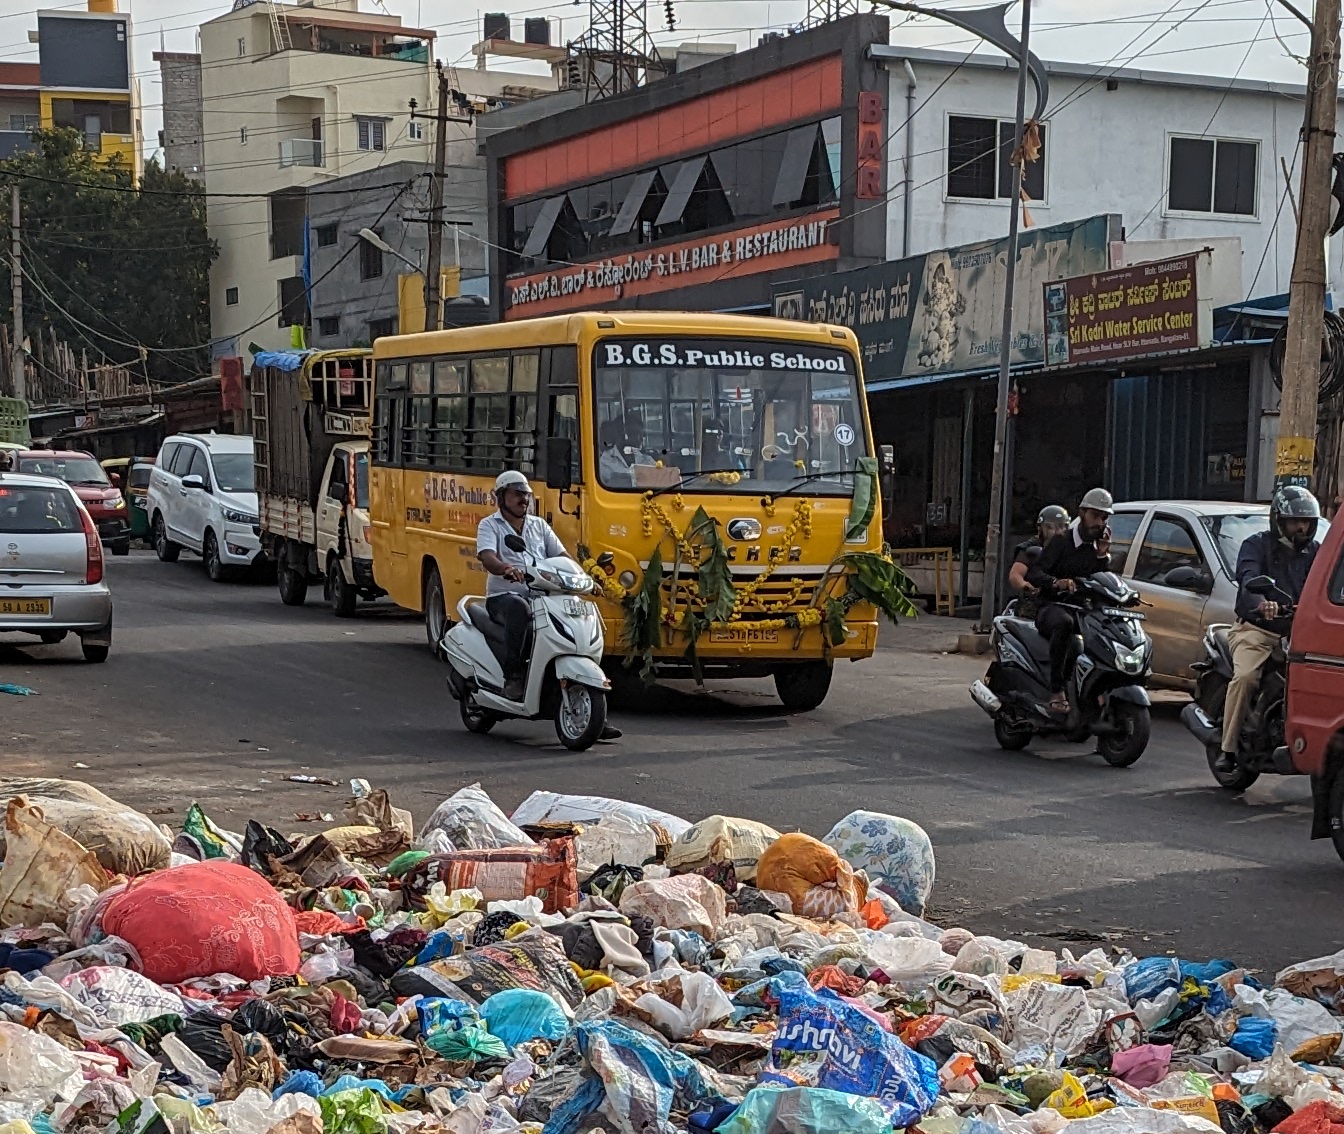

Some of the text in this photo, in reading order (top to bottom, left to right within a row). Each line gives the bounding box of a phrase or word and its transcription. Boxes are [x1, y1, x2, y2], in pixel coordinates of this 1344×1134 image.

[859, 91, 882, 197] BAR
[586, 270, 595, 288] &
[692, 243, 717, 269] BAR
[721, 241, 732, 263] &
[735, 219, 828, 261] RESTAURANT
[1069, 310, 1194, 345] Sri Kadri Water Service Center
[685, 350, 765, 367] Public
[770, 352, 846, 372] School
[836, 429, 851, 441] 17
[16, 602, 22, 612] A
